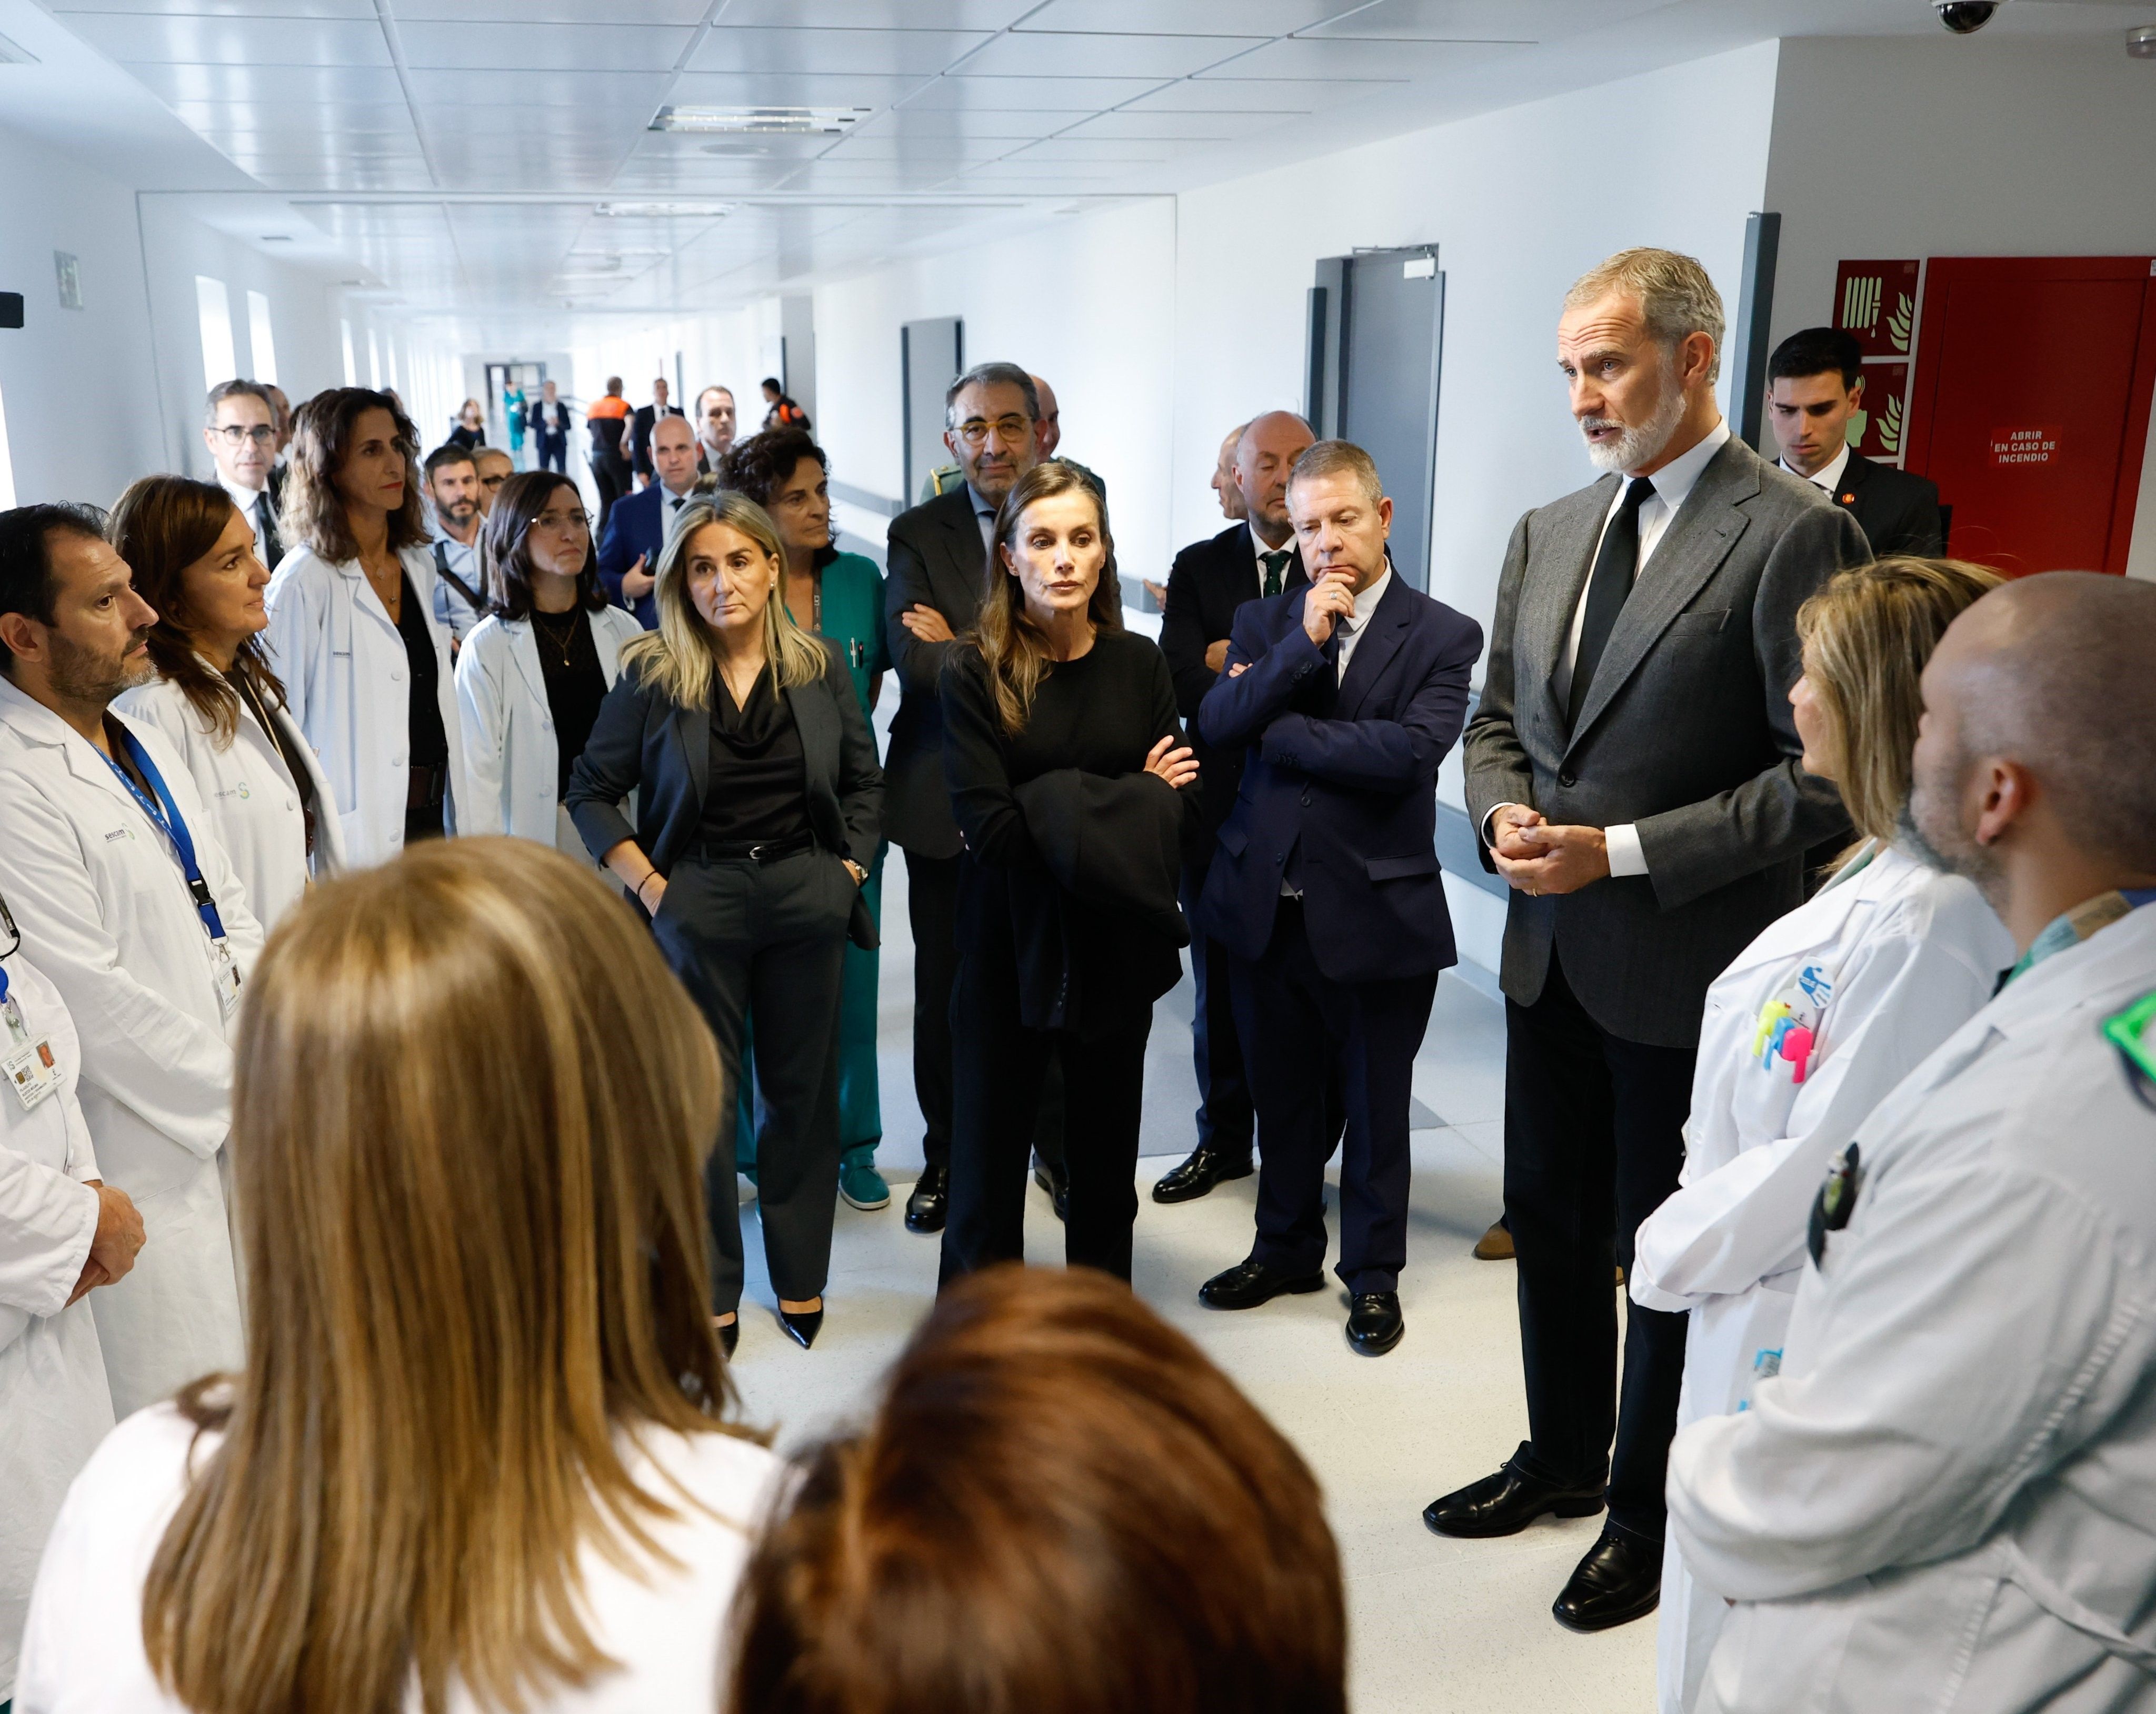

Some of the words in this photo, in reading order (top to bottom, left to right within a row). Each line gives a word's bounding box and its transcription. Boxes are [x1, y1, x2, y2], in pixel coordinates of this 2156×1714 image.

[2010, 430, 2042, 440] ABRIR
[1994, 443, 2008, 452] EN
[2011, 442, 2039, 452] CASO
[2042, 441, 2055, 450] DE
[1998, 452, 2049, 463] INCENDIO
[105, 829, 125, 840] sescam
